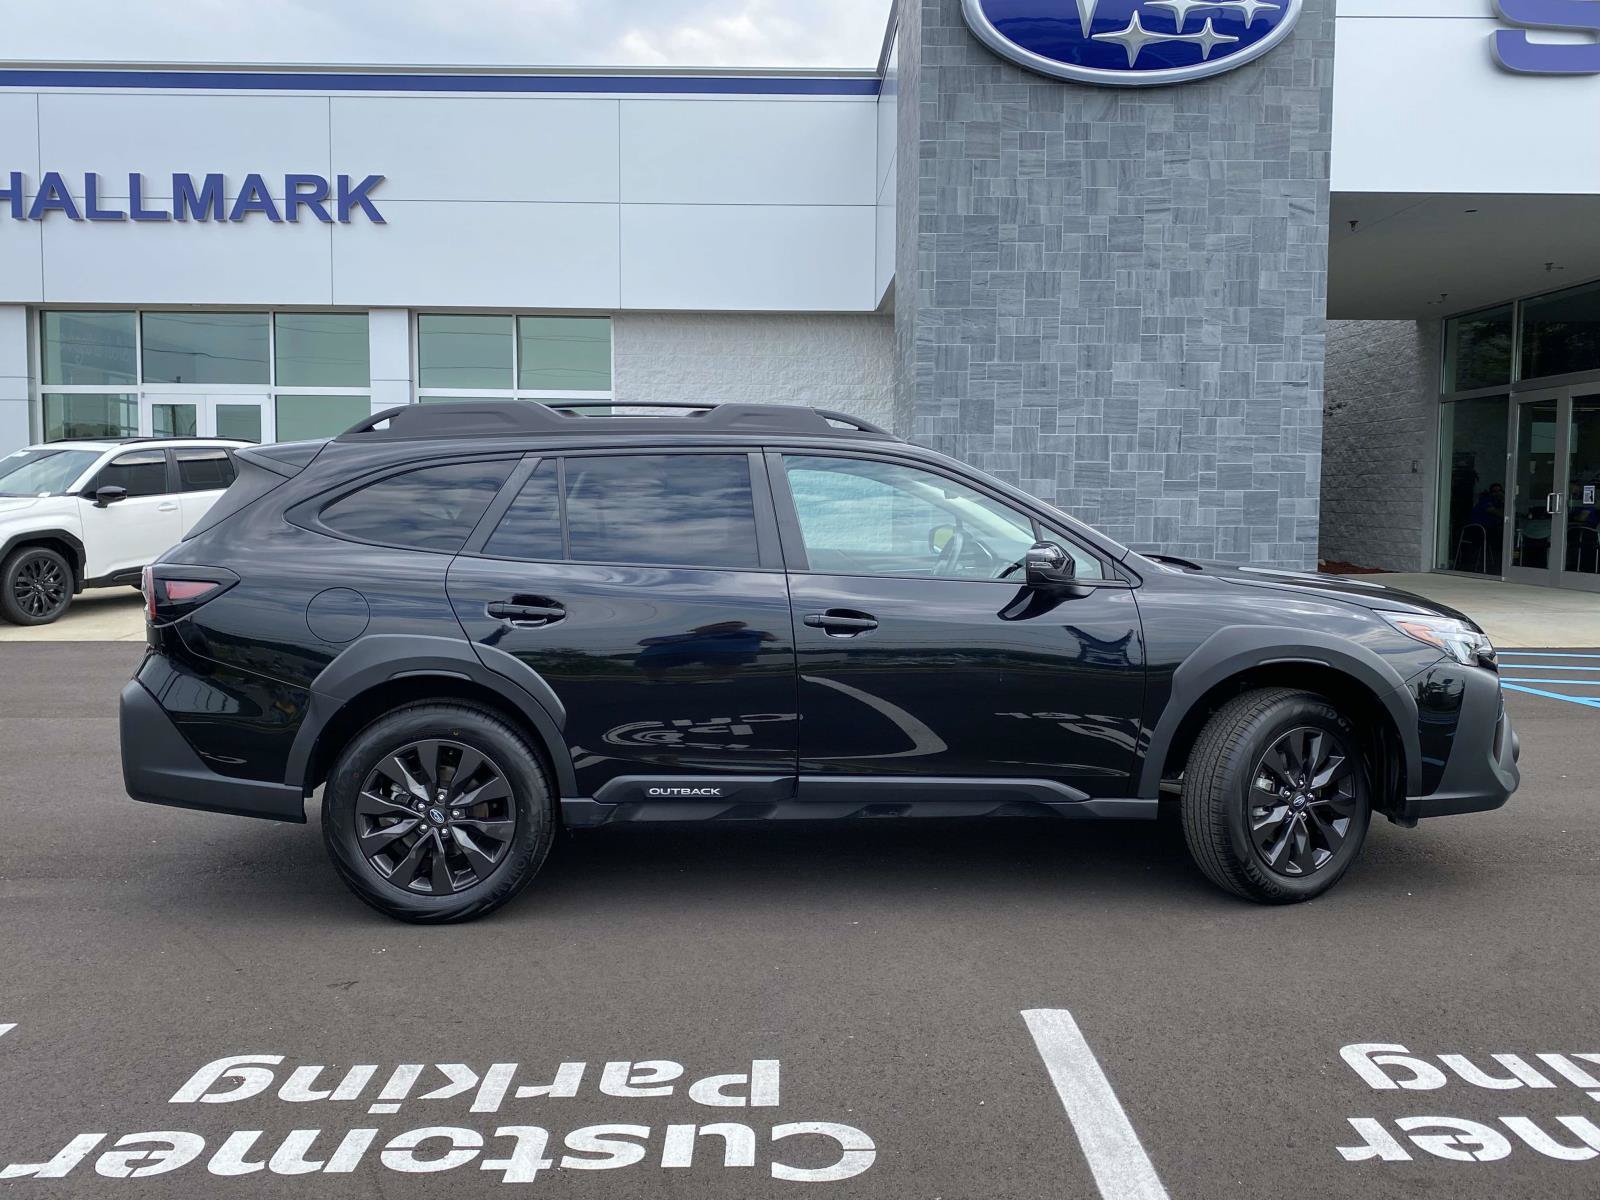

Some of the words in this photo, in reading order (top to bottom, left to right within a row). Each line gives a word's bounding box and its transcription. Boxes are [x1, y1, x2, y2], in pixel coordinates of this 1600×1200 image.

[0, 171, 387, 224] HALLMARK
[648, 787, 721, 796] OUTBACK
[169, 1055, 780, 1113] Parking
[0, 1122, 877, 1182] Customer
